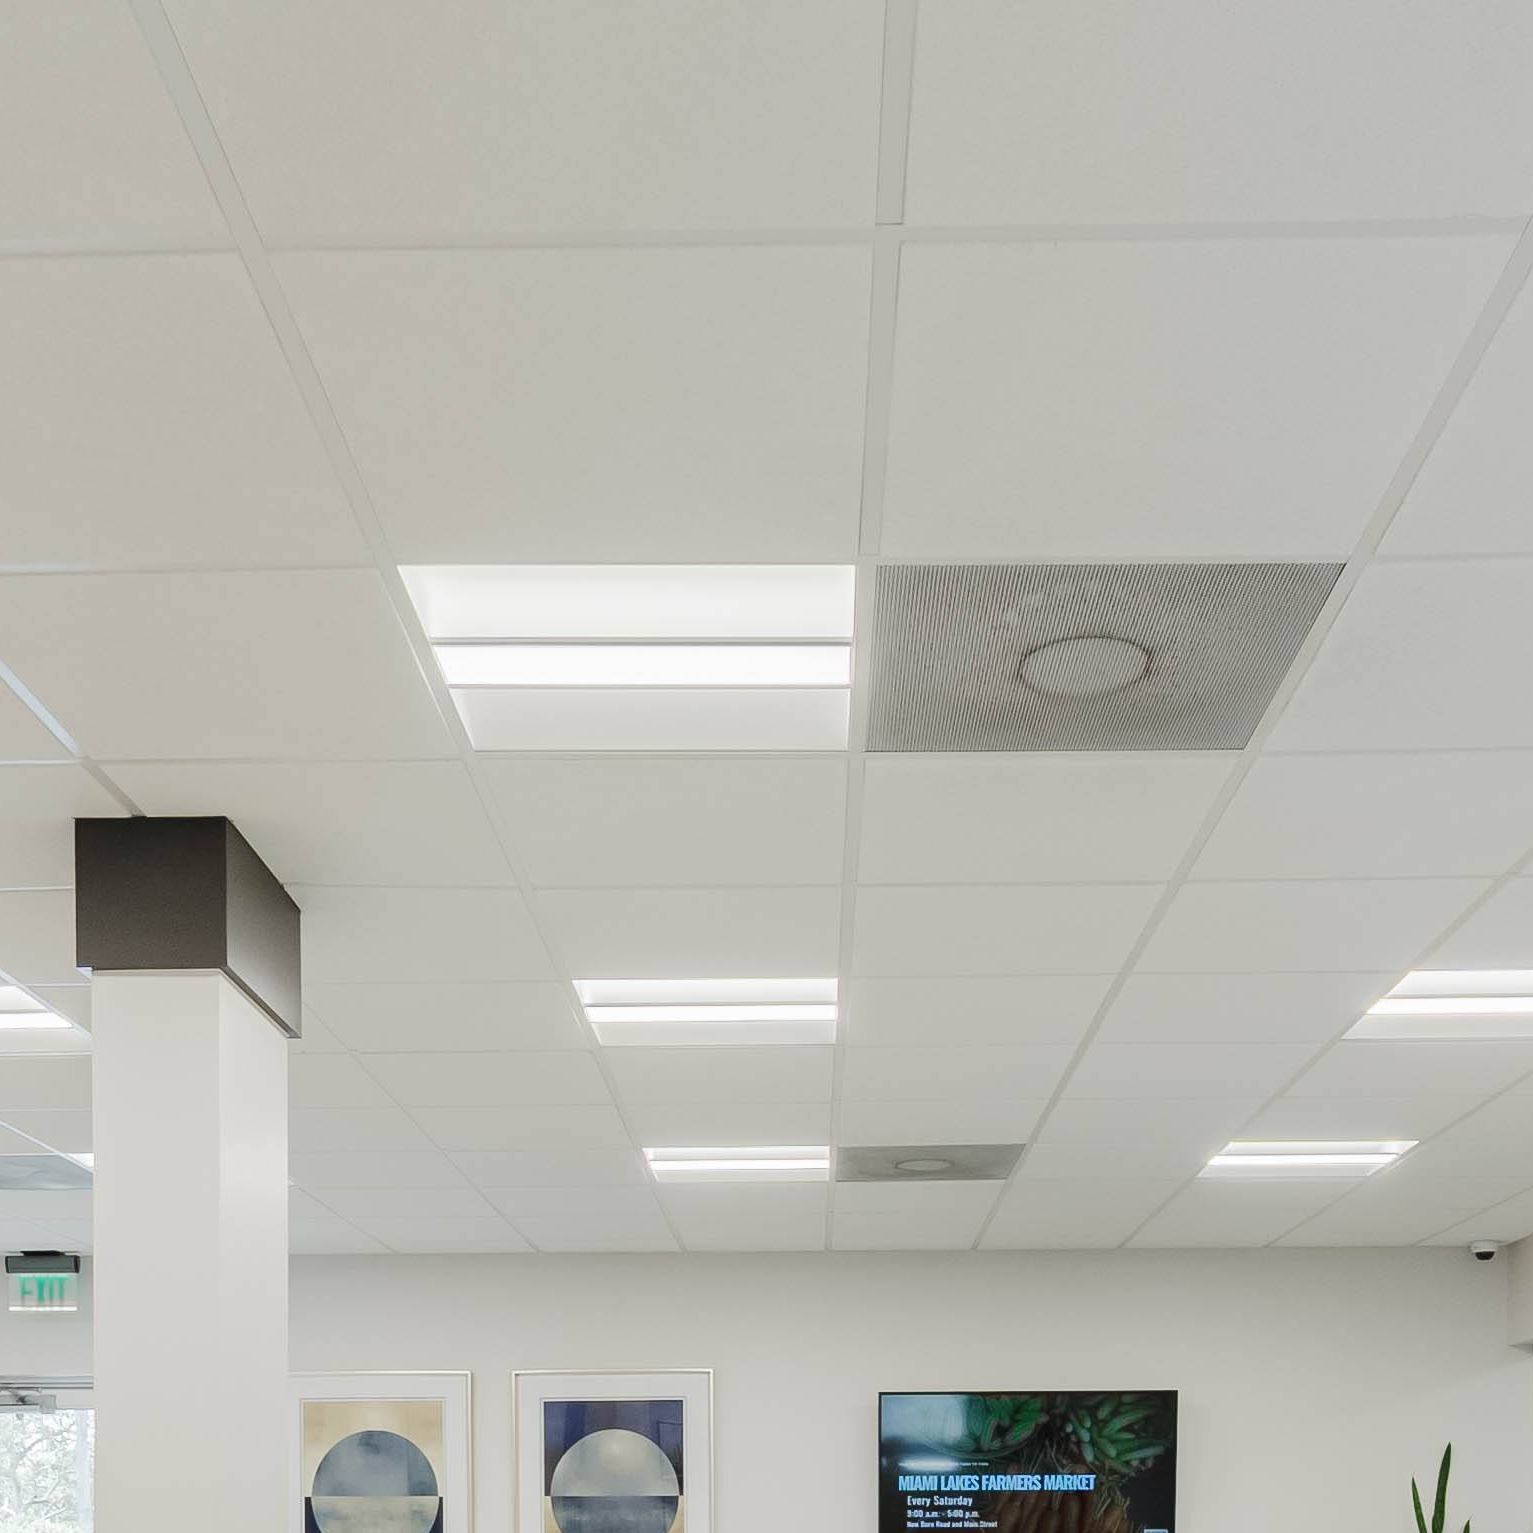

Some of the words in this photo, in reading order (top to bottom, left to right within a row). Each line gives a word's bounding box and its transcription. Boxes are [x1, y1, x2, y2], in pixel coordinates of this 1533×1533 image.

[18, 1275, 69, 1306] EXIT
[898, 1475, 939, 1491] MIAMI
[940, 1475, 980, 1491] LAKES
[981, 1474, 1042, 1491] FARMERS
[1043, 1474, 1097, 1491] MARKET
[907, 1495, 931, 1507] Every
[933, 1495, 973, 1507] Saturday
